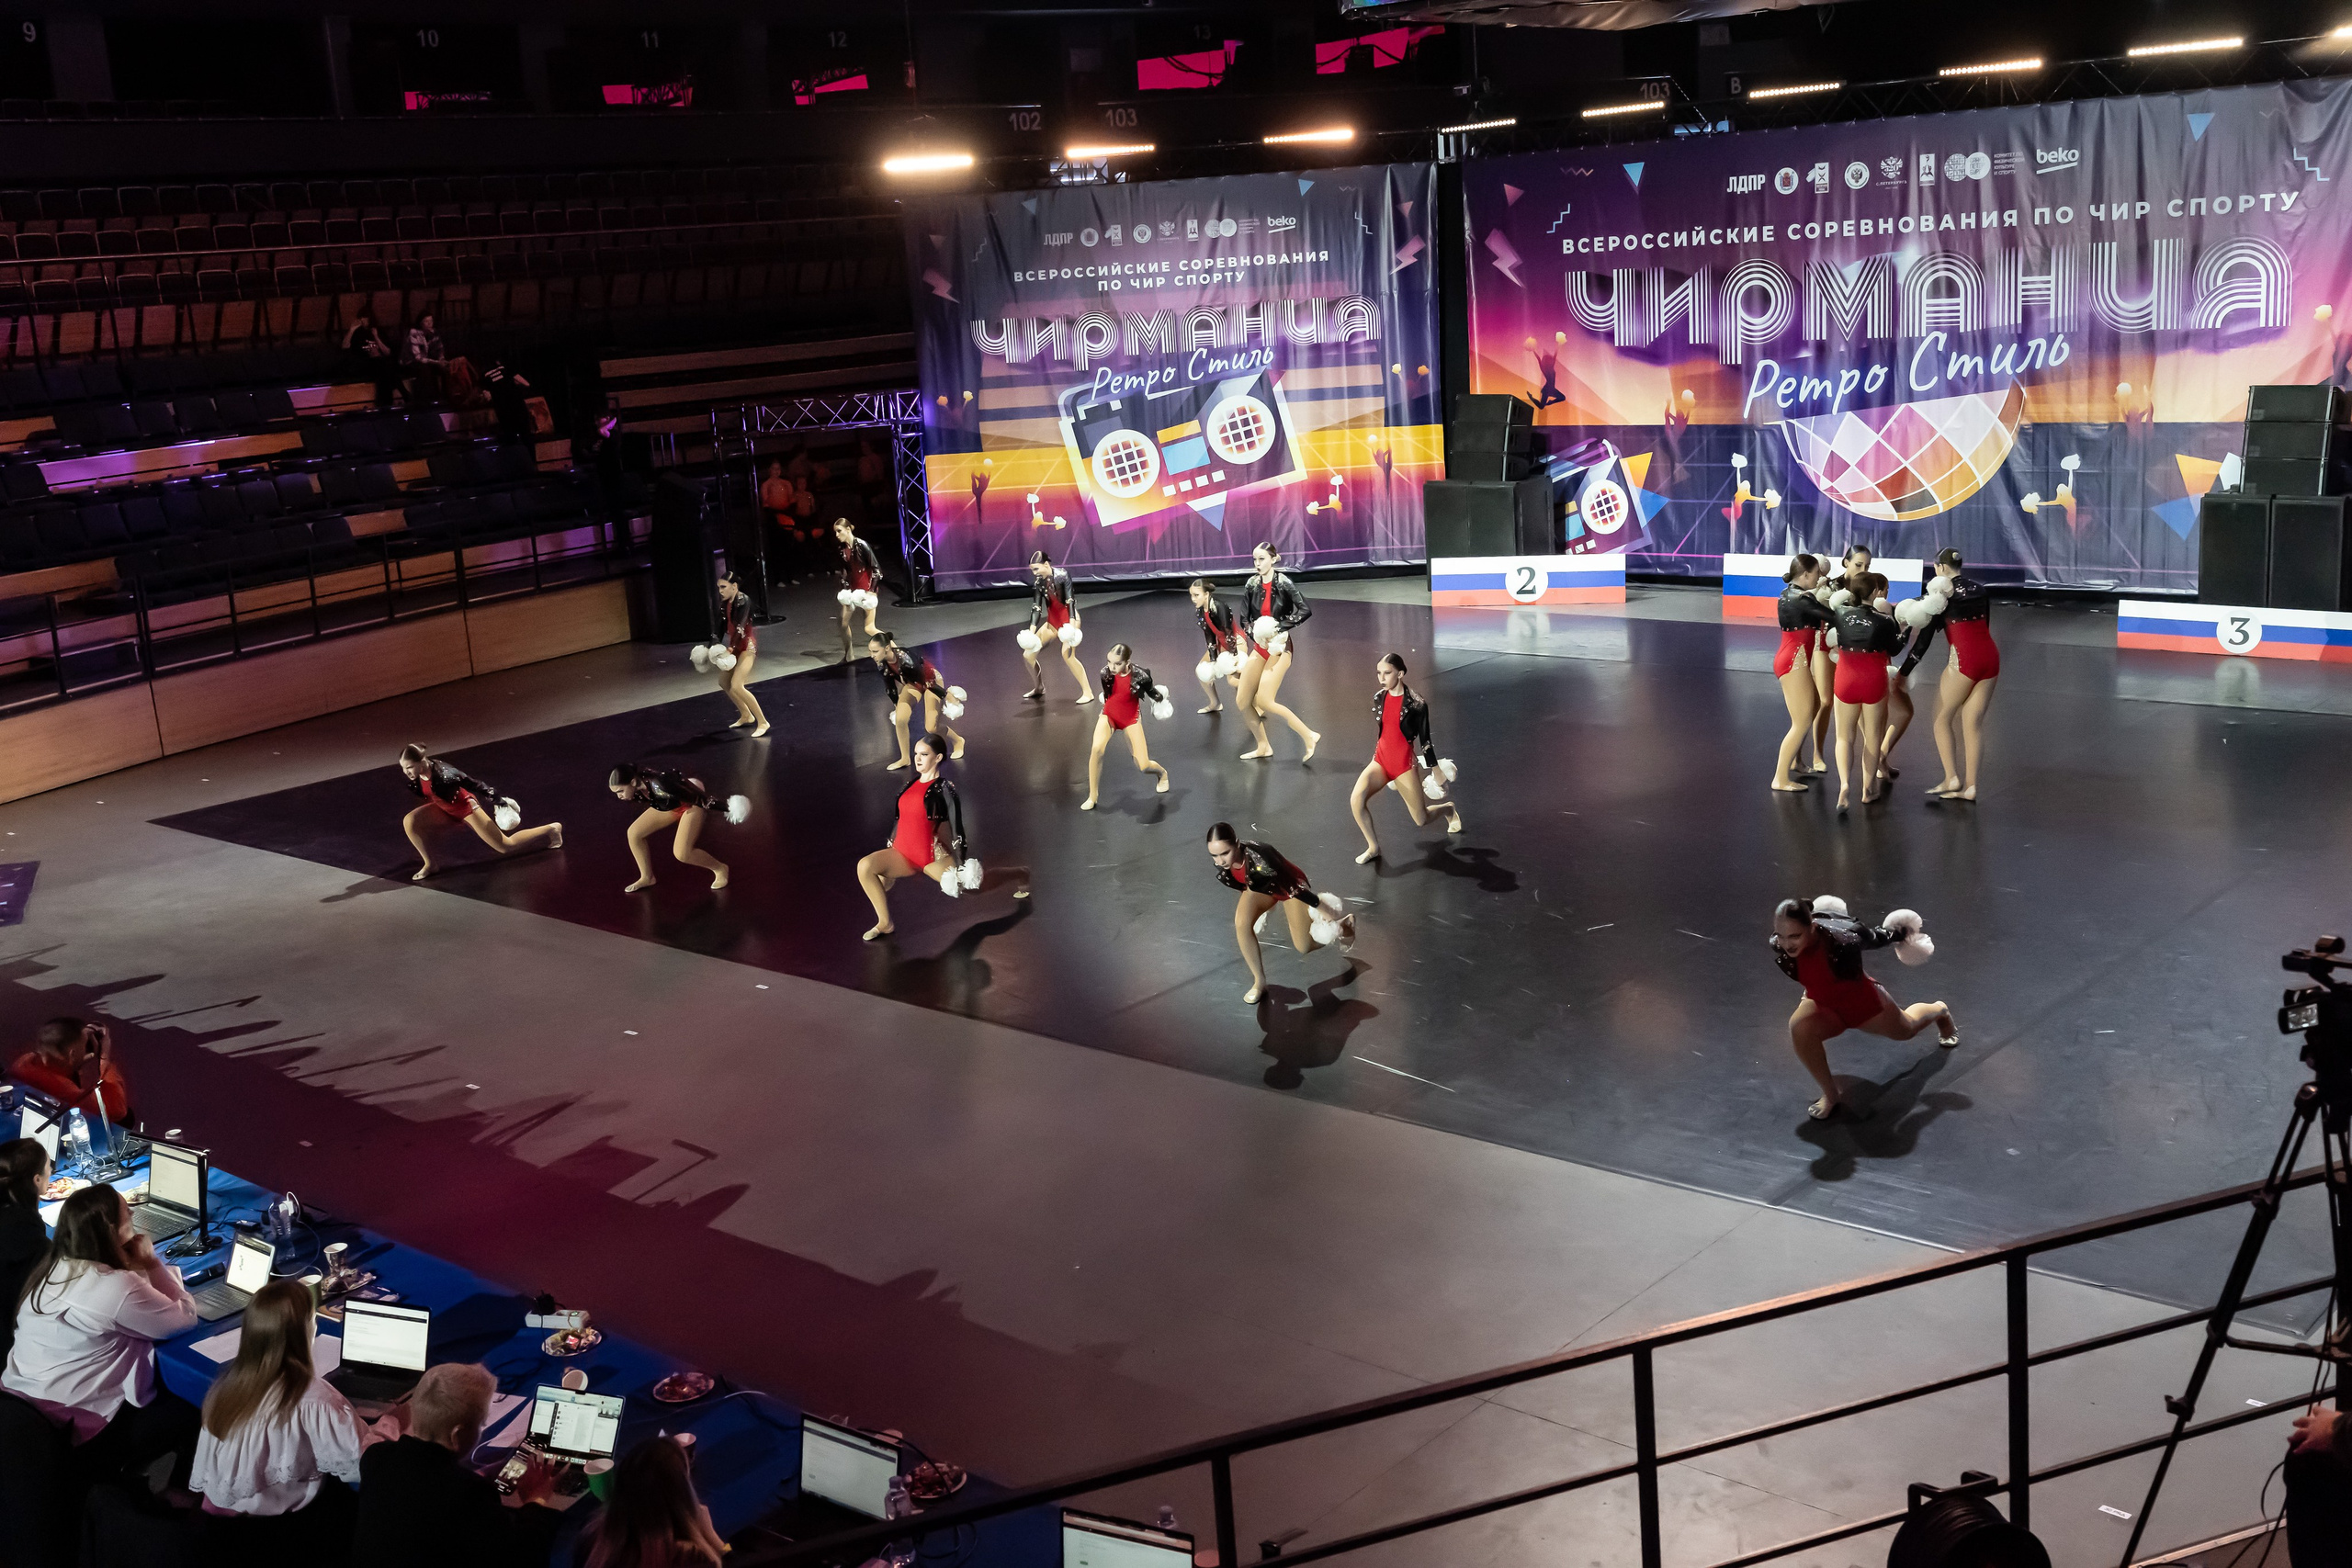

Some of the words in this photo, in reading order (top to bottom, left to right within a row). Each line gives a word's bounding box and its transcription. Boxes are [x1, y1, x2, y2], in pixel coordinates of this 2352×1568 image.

[23, 21, 36, 42] 9
[416, 29, 439, 47] 10
[641, 30, 659, 48] 11
[828, 31, 847, 47] 12
[1194, 25, 1211, 39] 13
[1640, 82, 1670, 99] 103
[1009, 111, 1042, 131] 102
[1105, 107, 1137, 128] 103
[2036, 147, 2079, 164] beko
[1726, 175, 1766, 195] ЛДПР
[1267, 216, 1296, 227] beko
[1563, 226, 1775, 254] ВСЕРОССИЙСКИЕ
[1787, 209, 2018, 240] СОРЕВНОВАНИЯ
[2034, 206, 2075, 225] ПО
[2089, 201, 2151, 221] ЧИР
[2166, 191, 2299, 217] СПОРТУ
[1044, 232, 1074, 247] ЛДПР
[1013, 261, 1170, 282] ВСЕРОССИЙСКИЕ
[1179, 250, 1329, 271] СОРЕВНОВАНИЯ
[1098, 279, 1122, 291] ПО
[1130, 276, 1166, 289] ЧИР
[1174, 271, 1245, 287] СПОРТУ
[1091, 366, 1176, 400] Ретро
[1188, 344, 1273, 381] Стиль
[1743, 358, 1888, 419] Ретро
[1908, 330, 2071, 390] Стиль
[1516, 566, 1536, 594] 2
[2228, 616, 2250, 645] 3
